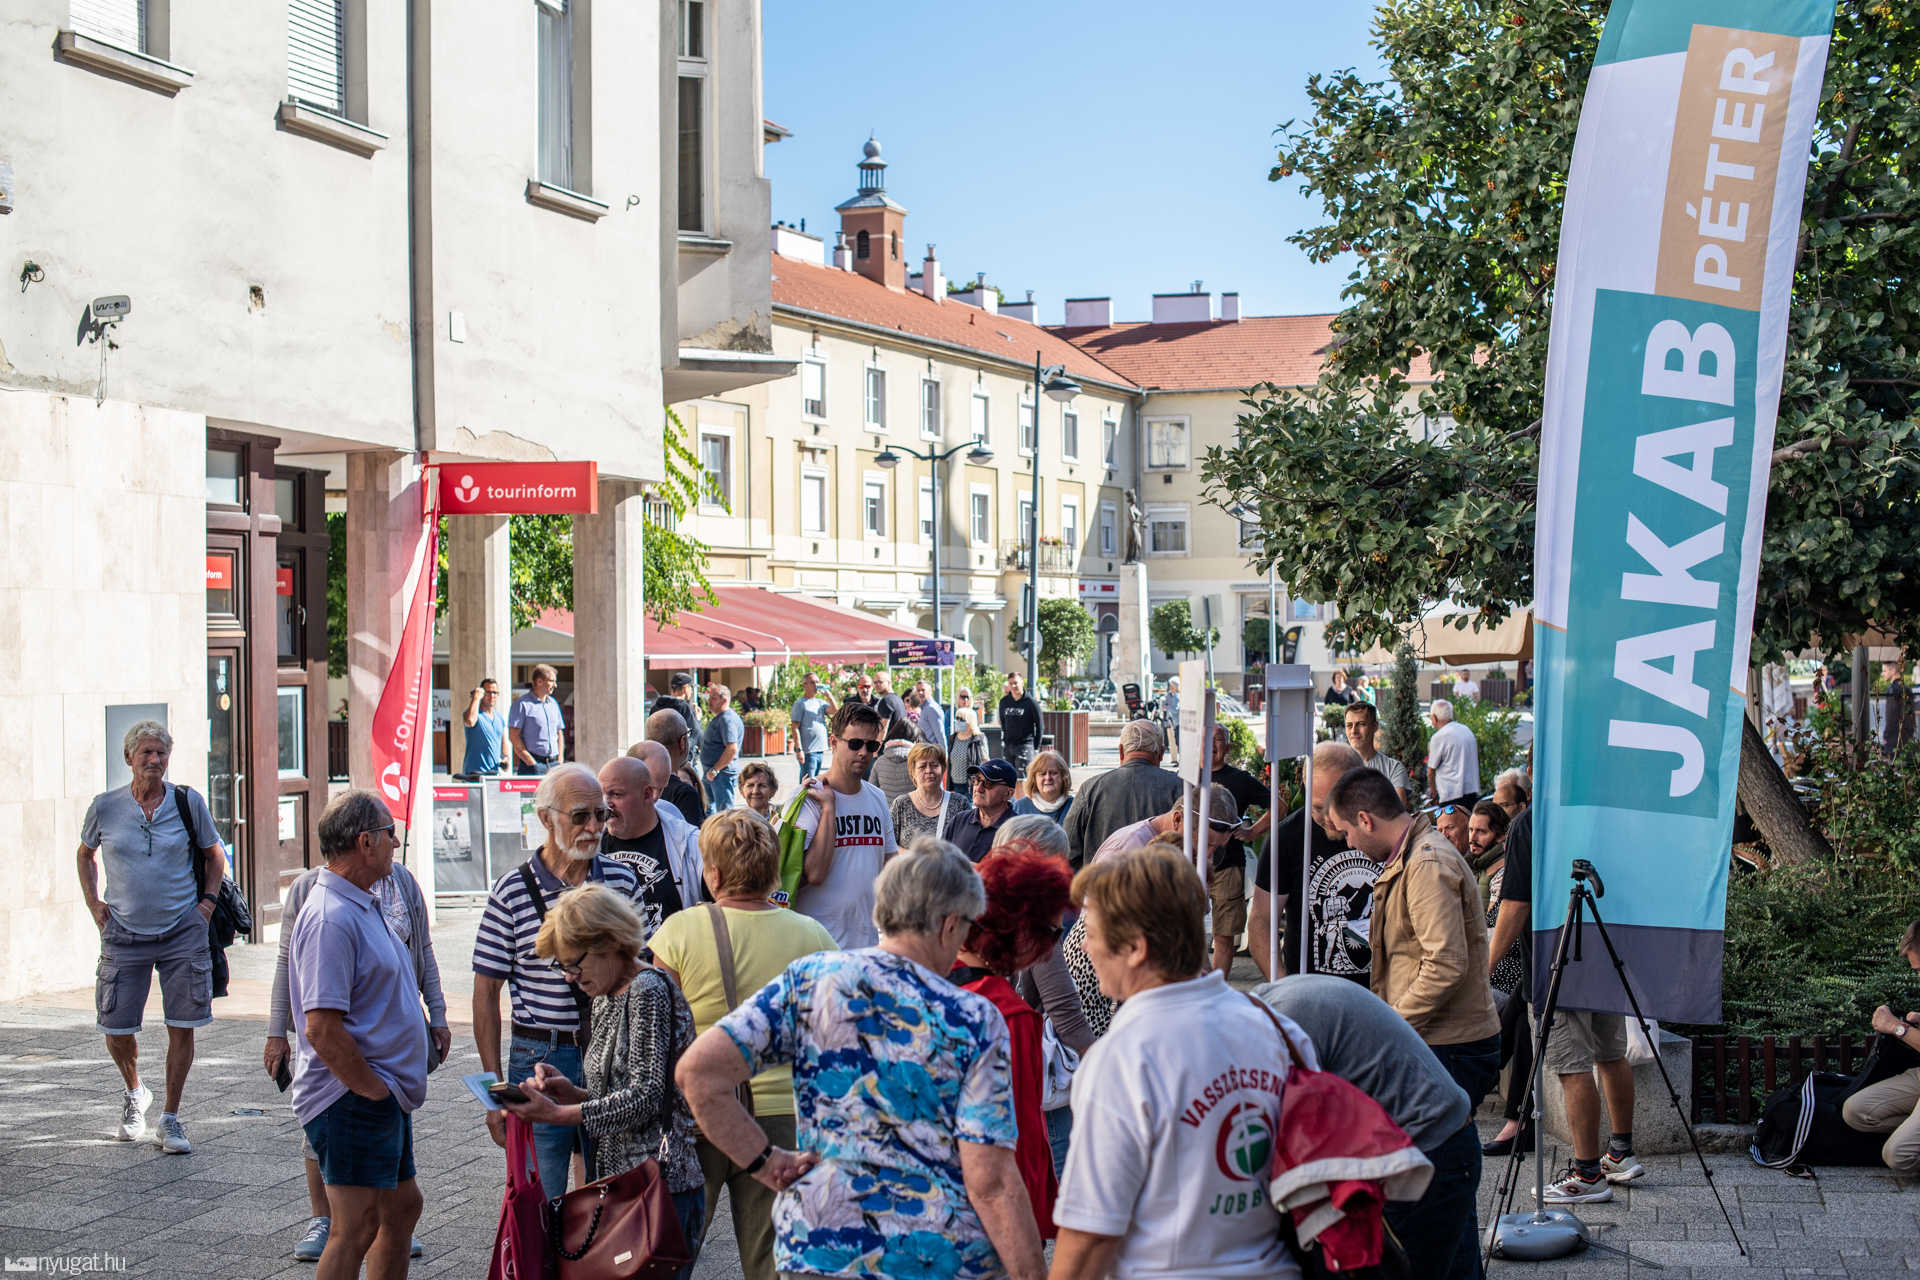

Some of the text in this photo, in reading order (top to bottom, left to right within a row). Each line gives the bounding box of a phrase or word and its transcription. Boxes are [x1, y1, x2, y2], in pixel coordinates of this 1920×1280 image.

[1608, 46, 1776, 798] JAKAB PÉTER
[487, 484, 577, 499] tourinform
[836, 815, 881, 836] UST DO
[1180, 1064, 1283, 1128] VASSZÉCSEN
[1209, 1188, 1263, 1215] JOBB
